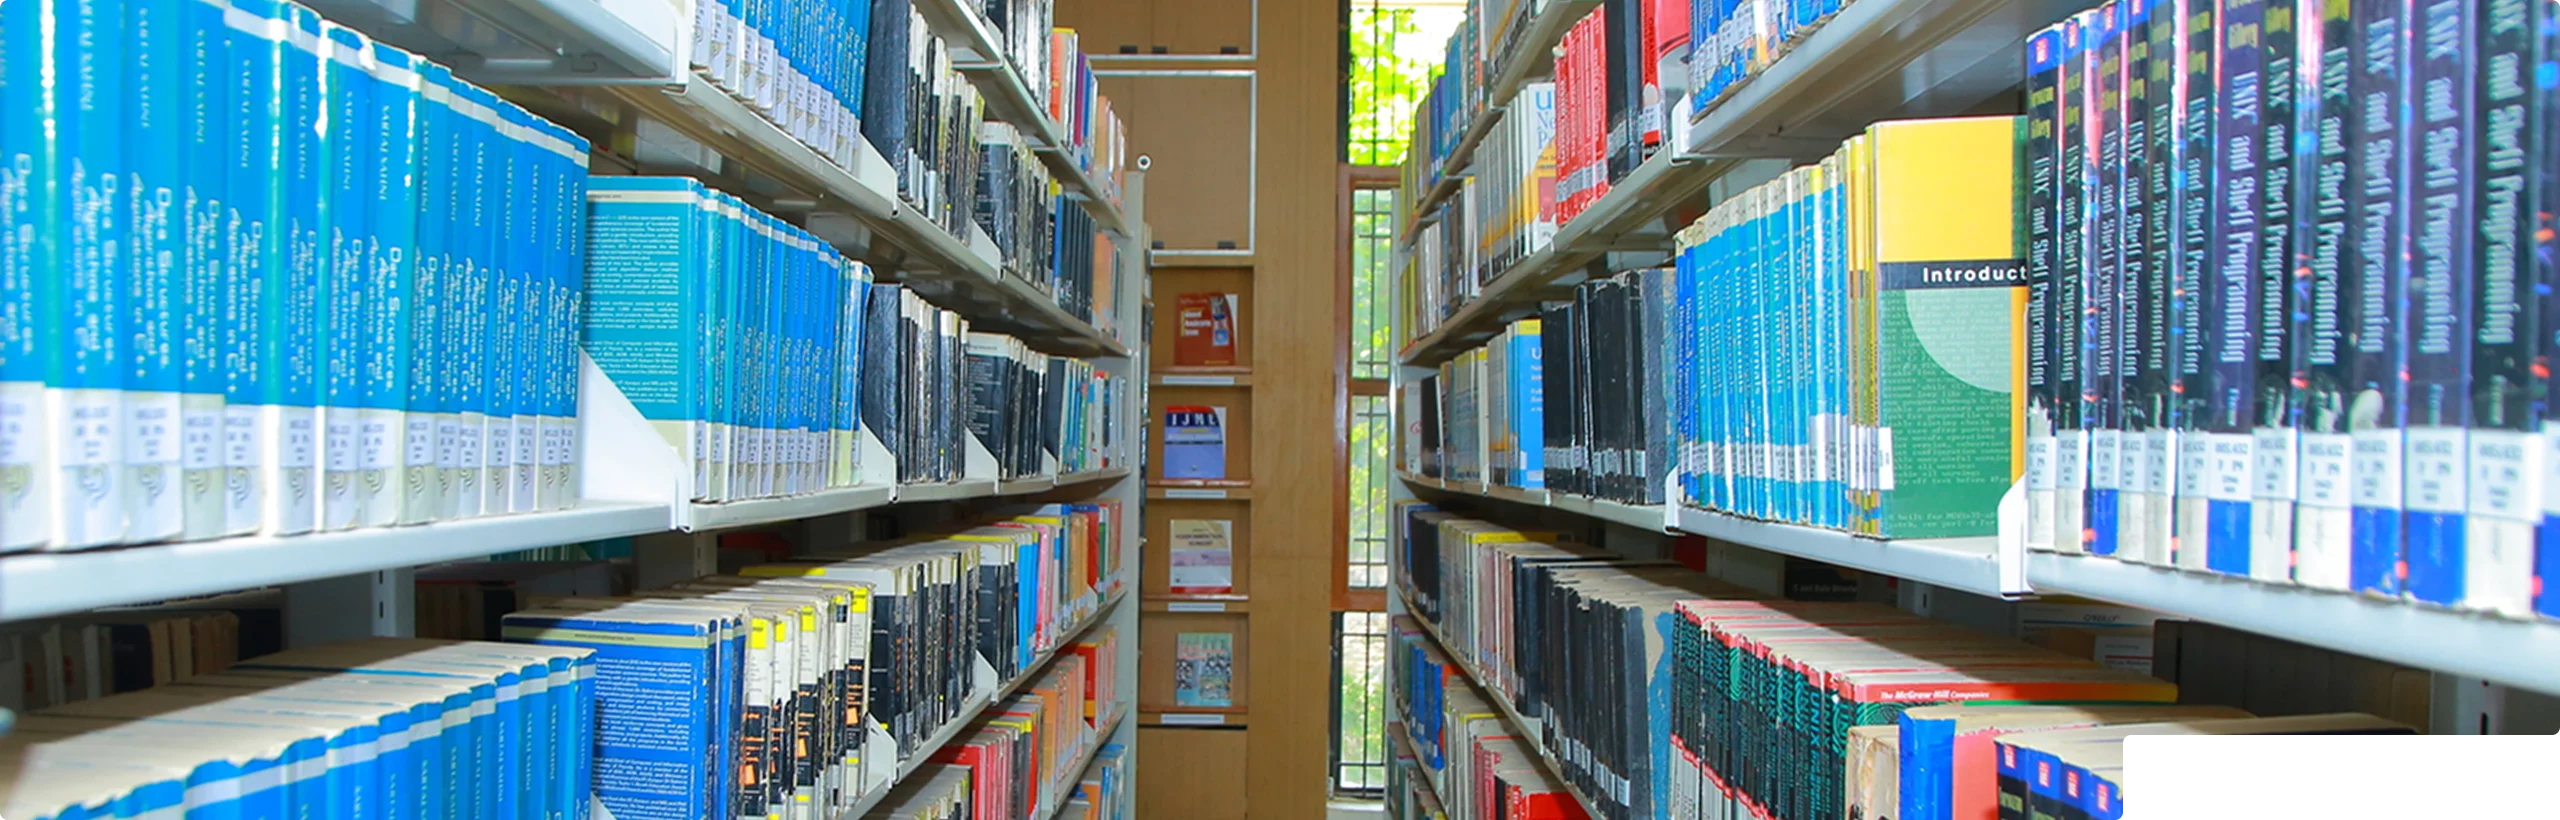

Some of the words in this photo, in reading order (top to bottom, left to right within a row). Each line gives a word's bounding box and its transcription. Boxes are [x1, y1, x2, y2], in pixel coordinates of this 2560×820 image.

[2365, 17, 2396, 80] UNIX
[2425, 0, 2461, 64] UNIX
[2231, 70, 2257, 124] UNIX
[2268, 57, 2290, 112] UNIX
[2323, 46, 2349, 104] UNIX
[2424, 77, 2460, 122] and
[2488, 52, 2526, 100] and
[2188, 96, 2207, 148] UNIX
[2320, 116, 2346, 156] and
[2364, 90, 2393, 134] and
[2102, 130, 2117, 173] UNIX
[2128, 120, 2144, 166] UNIX
[2228, 135, 2256, 172] and
[2265, 123, 2288, 161] and
[2423, 126, 2460, 188] Shell
[2486, 104, 2525, 171] Shell
[2033, 156, 2050, 198] UNIX
[2066, 144, 2079, 186] UNIX
[2187, 157, 2204, 192] and
[2318, 161, 2346, 216] Shell
[2363, 138, 2393, 196] Shell
[2065, 196, 2078, 226] and
[2102, 184, 2115, 214] and
[2127, 176, 2142, 208] and
[2227, 176, 2256, 226] Shell
[2265, 166, 2289, 218] Shell
[2034, 206, 2048, 235] and
[2101, 218, 2116, 261] Shell
[2126, 212, 2143, 256] Shell
[2187, 196, 2205, 243] Shell
[388, 246, 403, 289] Data
[2033, 238, 2050, 278] Shell
[2064, 228, 2078, 270] Shell
[2417, 193, 2460, 354] Programming
[2478, 174, 2525, 344] Programming
[1922, 265, 2027, 283] Introduct
[2219, 230, 2256, 363] Programming
[2259, 223, 2288, 360] Programming
[2308, 220, 2345, 364] Programming
[2358, 201, 2393, 353] Programming
[2030, 282, 2048, 386] Programming
[2061, 274, 2077, 382] Programming
[2124, 260, 2142, 377] Programming
[2182, 248, 2205, 374] Programming
[1810, 692, 1820, 747] UNIX
[1950, 690, 1990, 701] Companies
